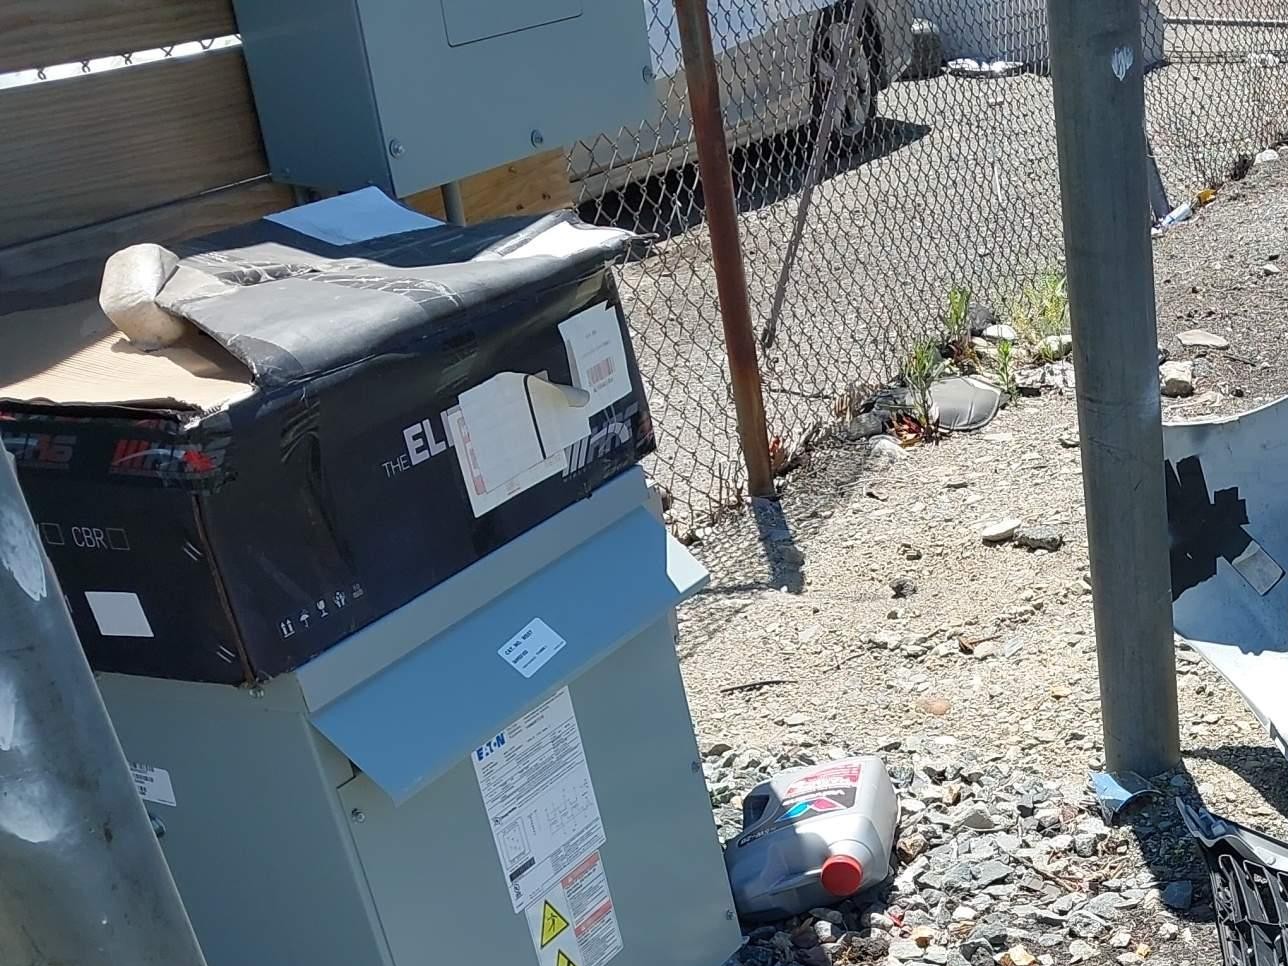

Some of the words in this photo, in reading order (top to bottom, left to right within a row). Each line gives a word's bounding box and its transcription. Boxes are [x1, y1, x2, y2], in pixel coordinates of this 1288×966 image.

[382, 455, 410, 478] THE
[403, 404, 461, 466] ELI
[71, 526, 108, 549] CBR
